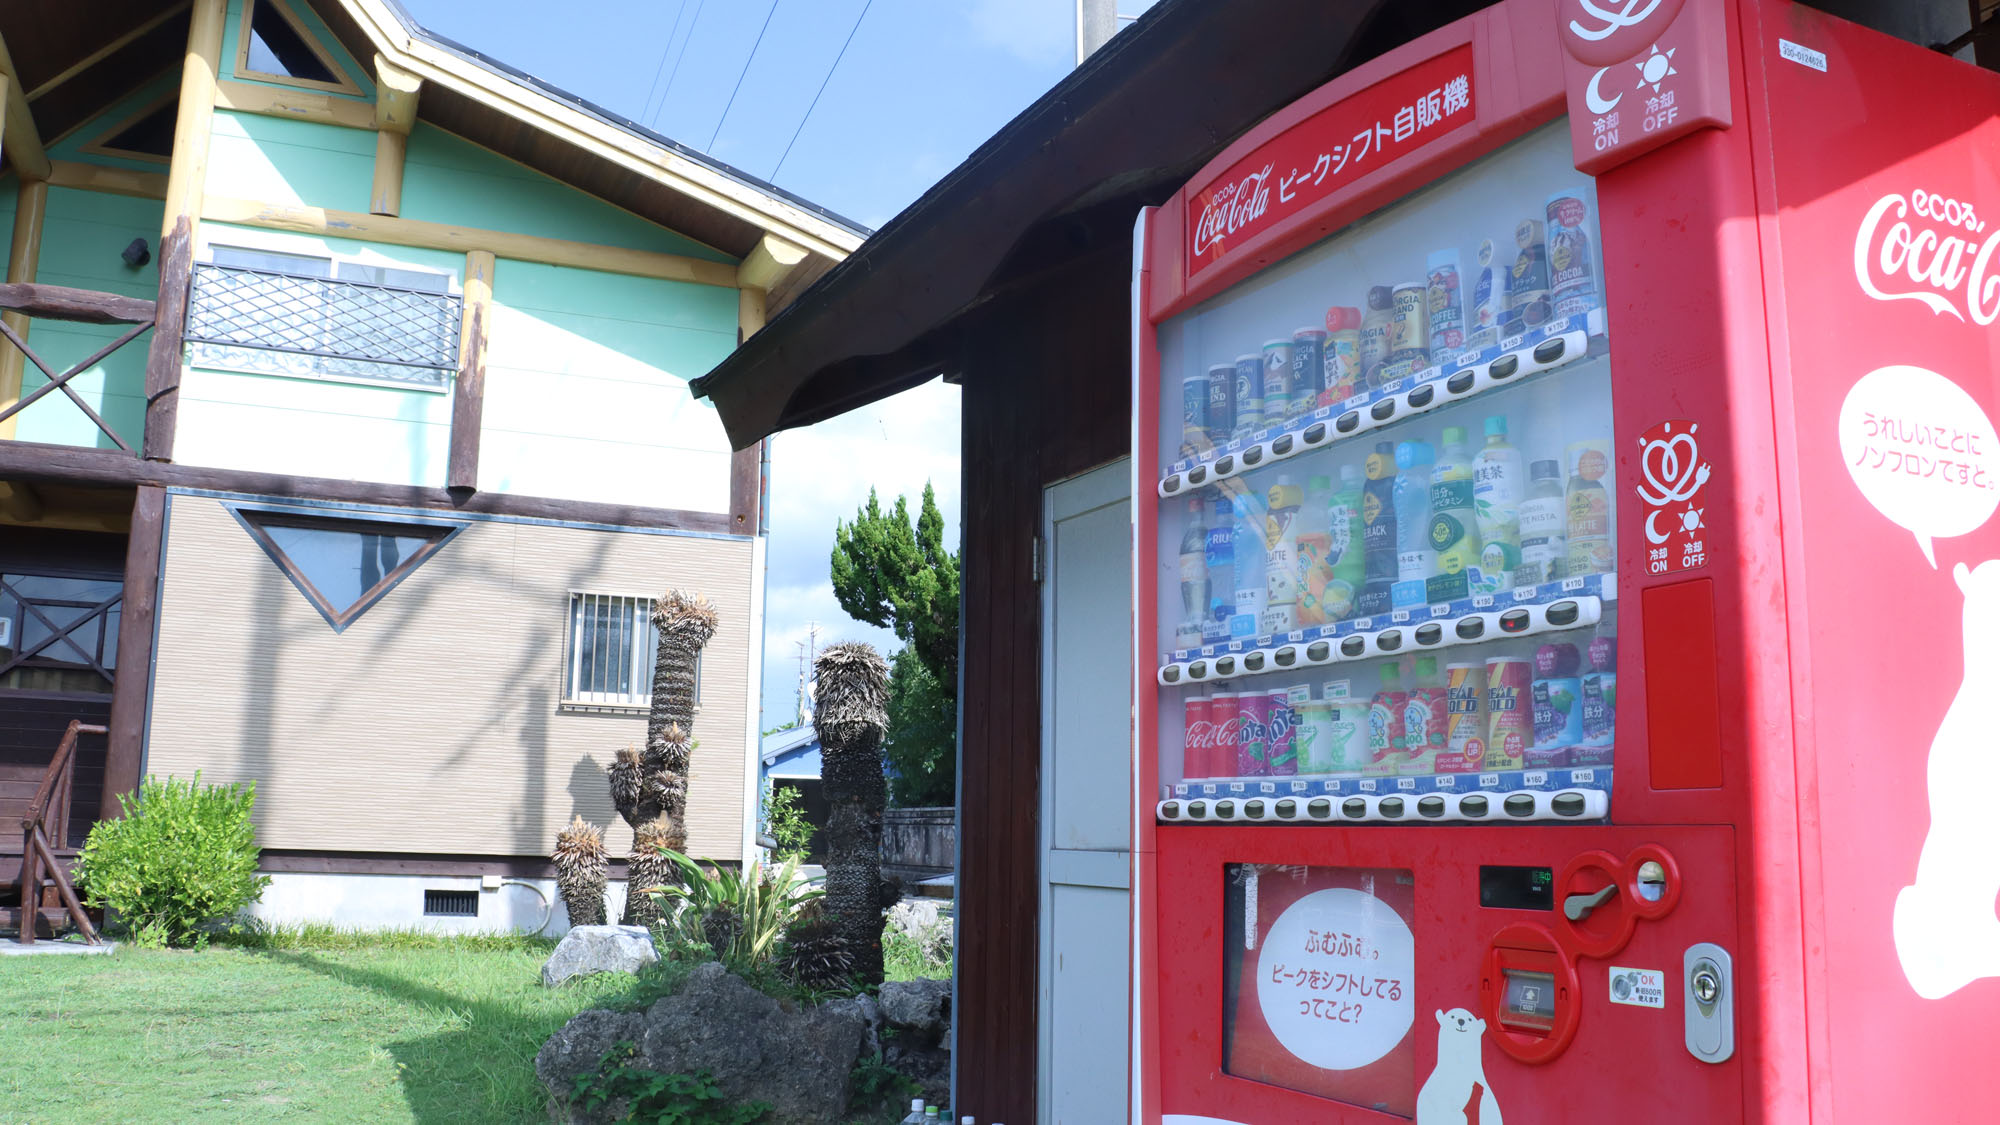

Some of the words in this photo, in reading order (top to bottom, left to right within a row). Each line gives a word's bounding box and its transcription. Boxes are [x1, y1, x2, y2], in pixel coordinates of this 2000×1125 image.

[1645, 90, 1674, 115] 冷却
[1592, 111, 1619, 136] 冷却
[1643, 106, 1679, 132] OFF
[1279, 74, 1470, 203] ピークシフト自販機
[1594, 128, 1619, 151] ON
[1194, 161, 1275, 256] Coca-Cola
[1863, 411, 1982, 456] うれしいことに
[1650, 547, 1668, 561] 冷却
[1683, 540, 1703, 555] 冷却
[1651, 560, 1668, 573] ON
[1682, 553, 1705, 567] OFF
[1566, 579, 1582, 589] ¥170
[1438, 777, 1453, 785] ¥140
[1481, 777, 1496, 785] ¥140
[1526, 775, 1542, 784] ¥160
[1575, 772, 1591, 781] ¥160
[1271, 963, 1402, 1002] ピークをシフトしてる
[1641, 974, 1656, 986] OK
[1299, 998, 1363, 1024] ってこと?
